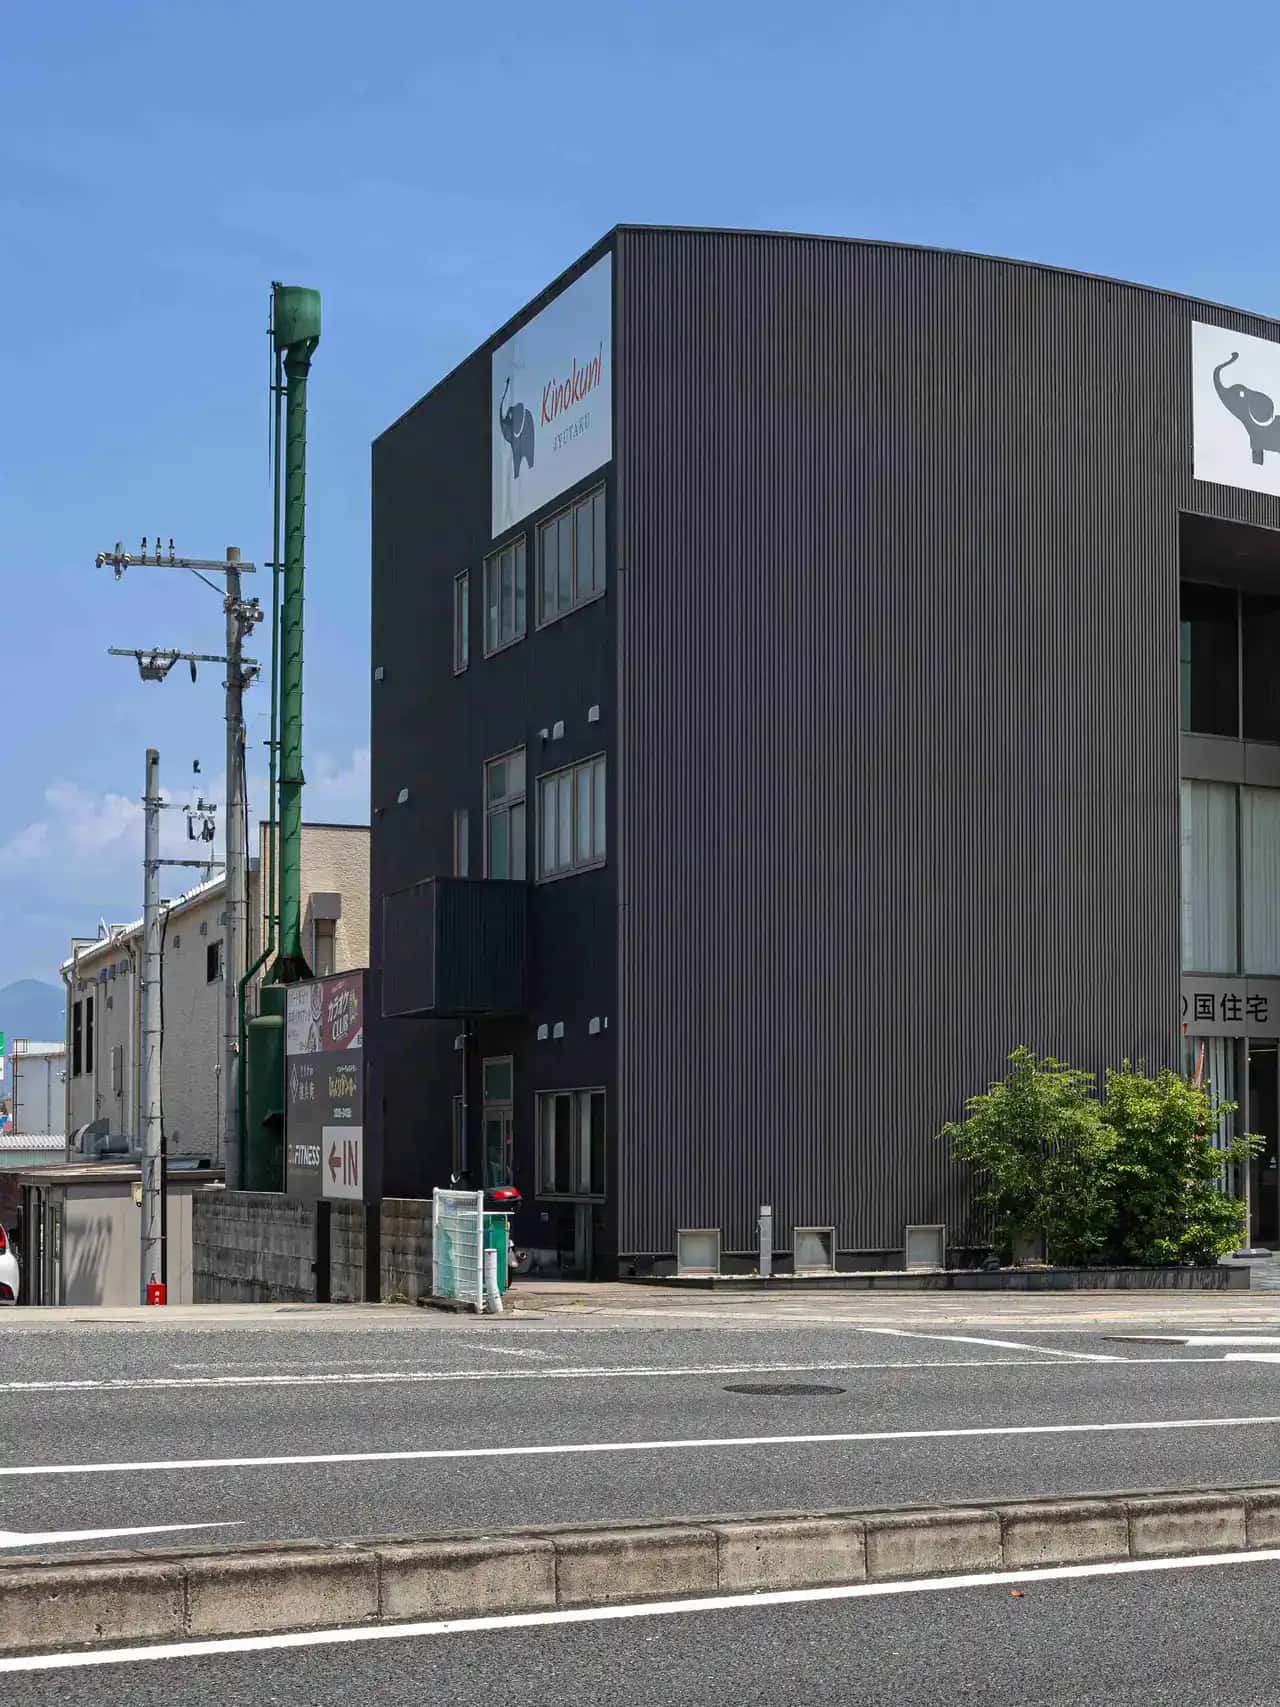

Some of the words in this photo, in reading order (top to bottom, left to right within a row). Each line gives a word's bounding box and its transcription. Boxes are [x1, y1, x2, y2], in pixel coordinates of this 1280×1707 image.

[541, 340, 603, 427] Kinokuni
[1182, 992, 1268, 1023] 国住宅
[343, 1140, 358, 1186] IN
